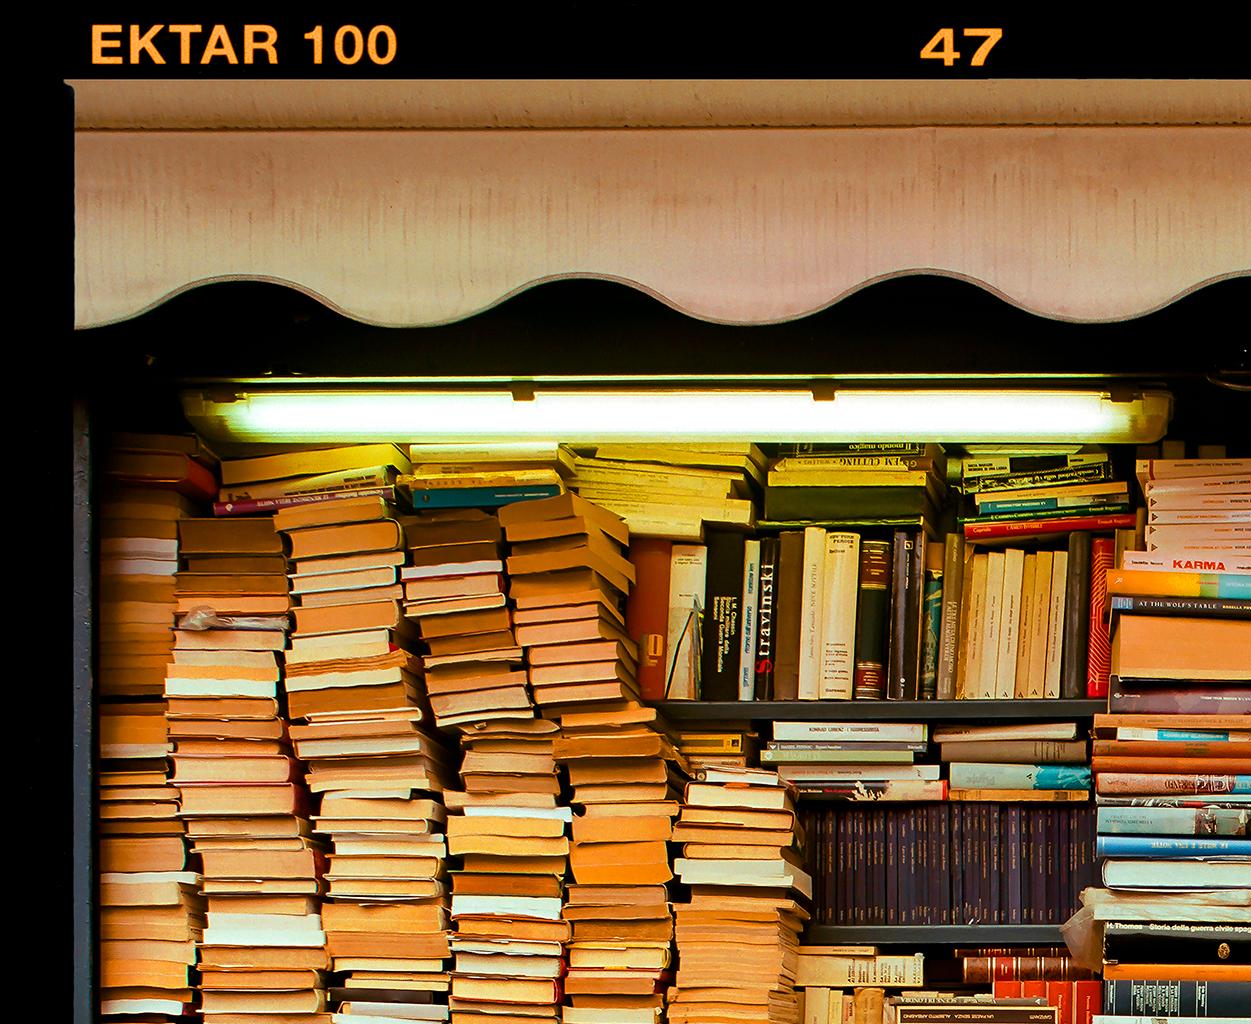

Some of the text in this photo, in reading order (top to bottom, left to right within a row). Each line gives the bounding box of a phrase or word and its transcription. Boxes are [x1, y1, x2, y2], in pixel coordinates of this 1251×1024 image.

[839, 458, 880, 466] CUTTING
[1173, 559, 1225, 571] KARMA
[755, 564, 774, 673] Stravinski
